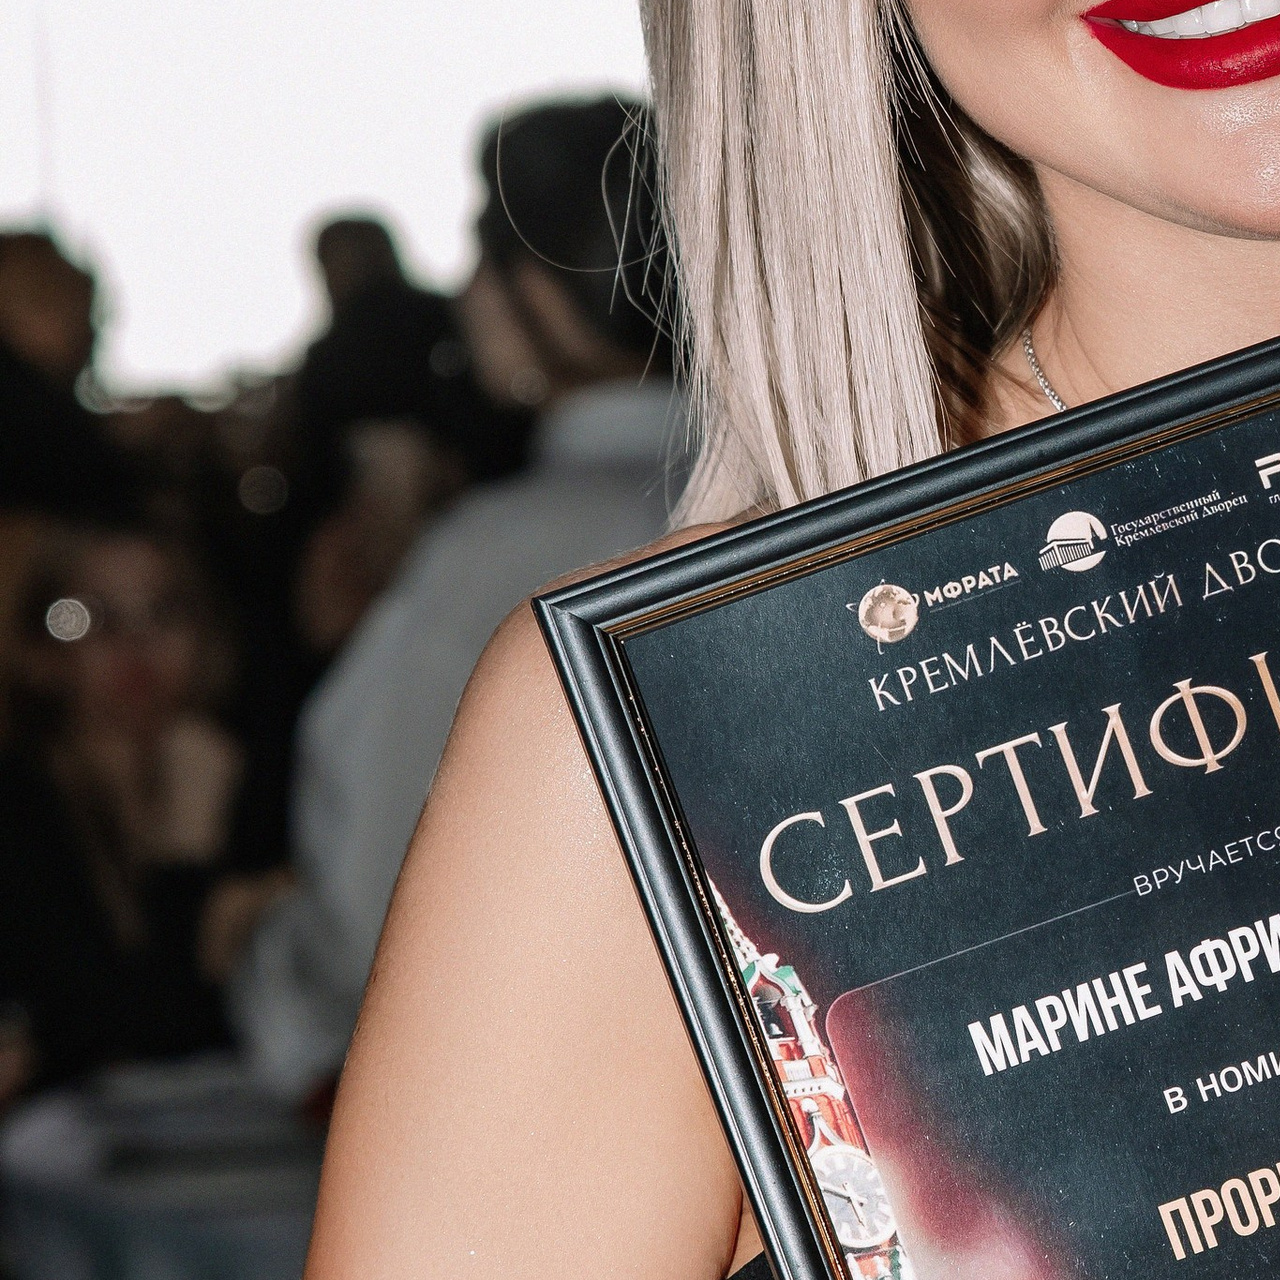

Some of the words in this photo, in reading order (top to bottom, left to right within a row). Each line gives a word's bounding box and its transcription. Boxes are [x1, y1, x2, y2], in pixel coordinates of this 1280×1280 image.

[1110, 489, 1221, 536] Государственный
[1202, 494, 1248, 518] Дворец
[923, 561, 1019, 607] МФРАТА
[867, 571, 1183, 712] КРЕМЛЁВСКИЙ
[966, 961, 1163, 1077] МАРИНЕ
[1162, 1084, 1188, 1115] в
